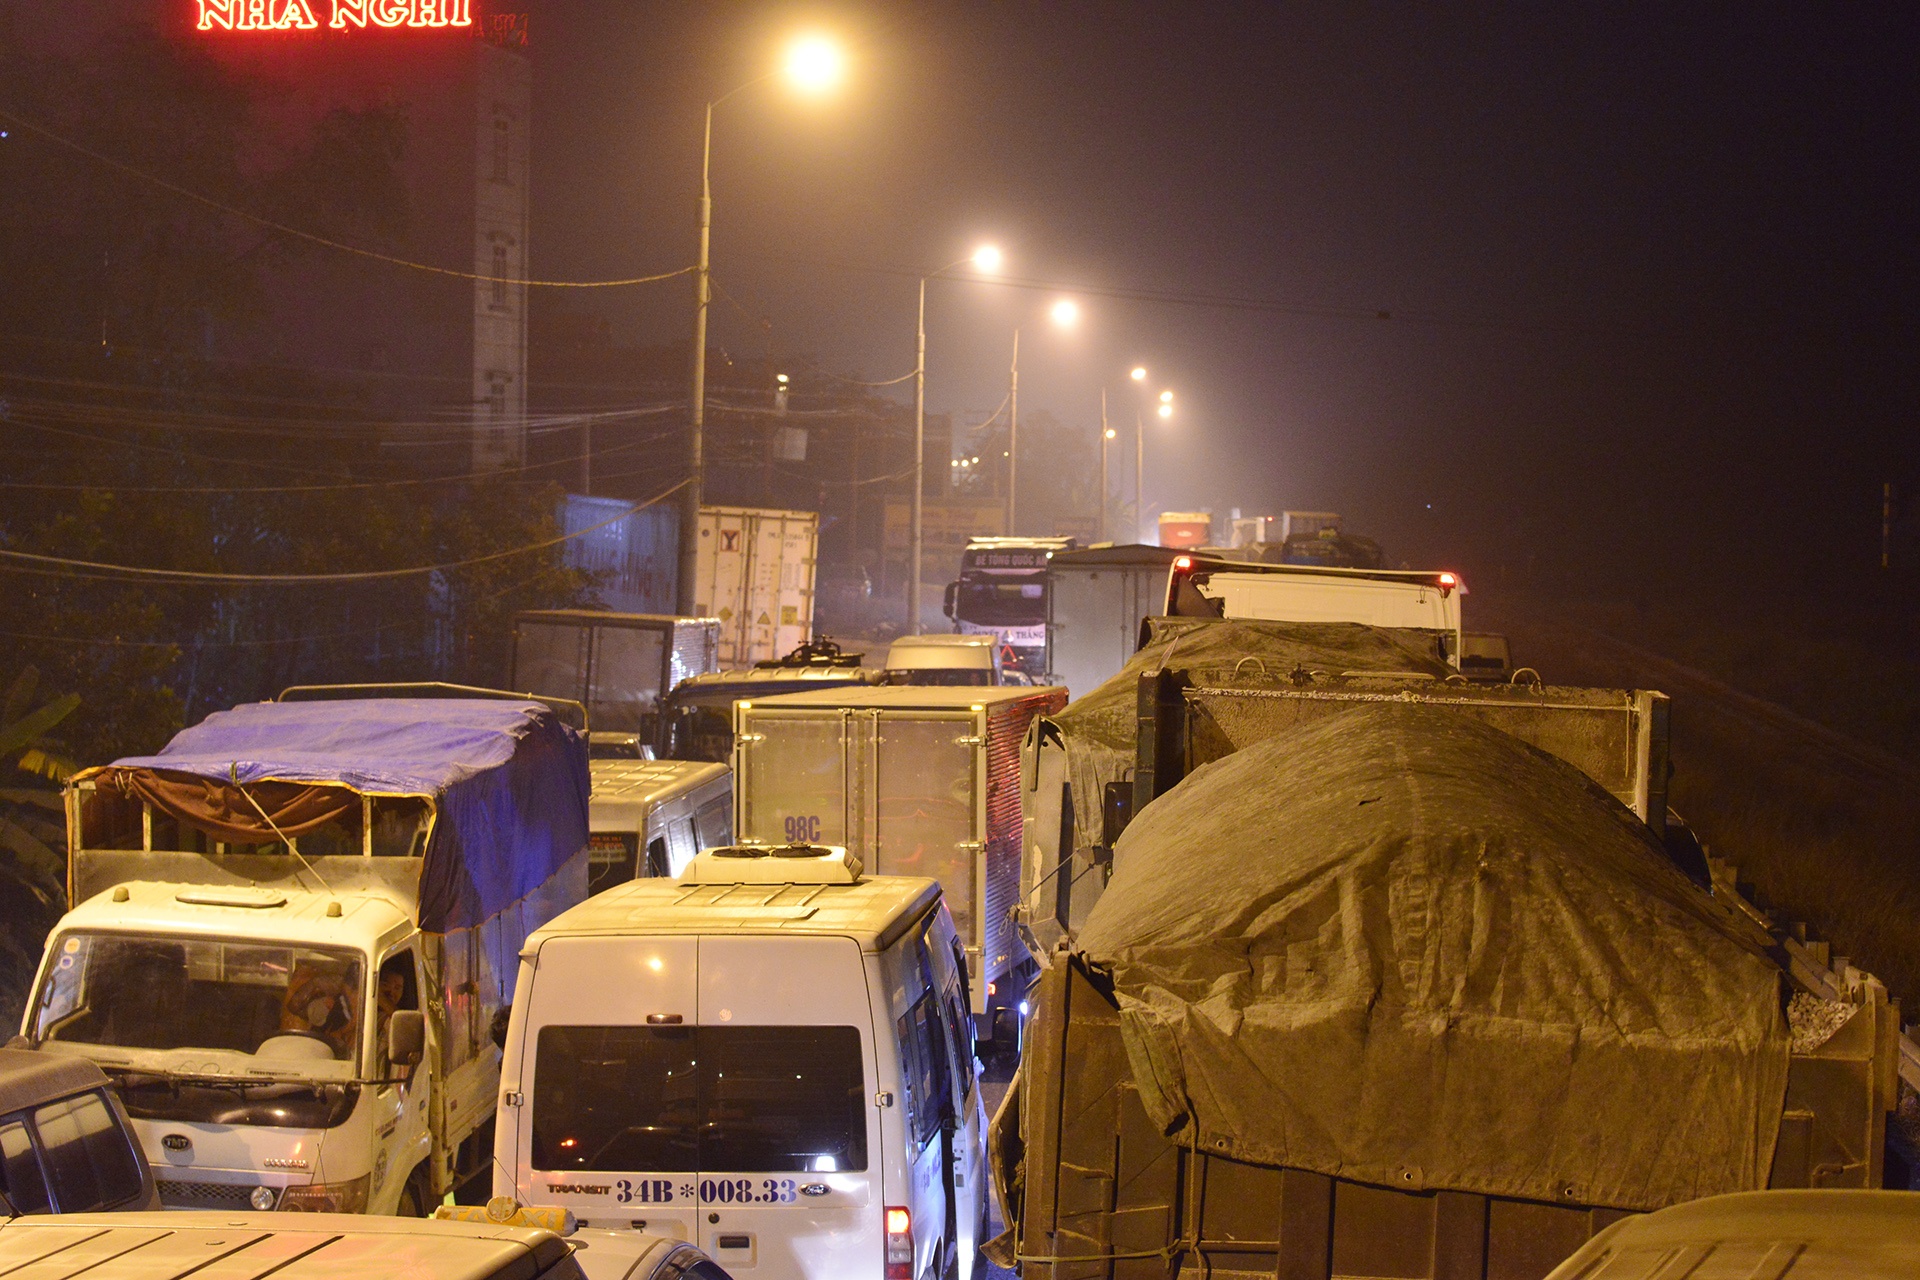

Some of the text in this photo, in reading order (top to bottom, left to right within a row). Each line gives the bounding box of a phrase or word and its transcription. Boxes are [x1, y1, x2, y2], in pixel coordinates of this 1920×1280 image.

[784, 815, 821, 843] 98C
[165, 1137, 188, 1147] TMT
[547, 1179, 798, 1203] TRANSIT 34B 008.33
